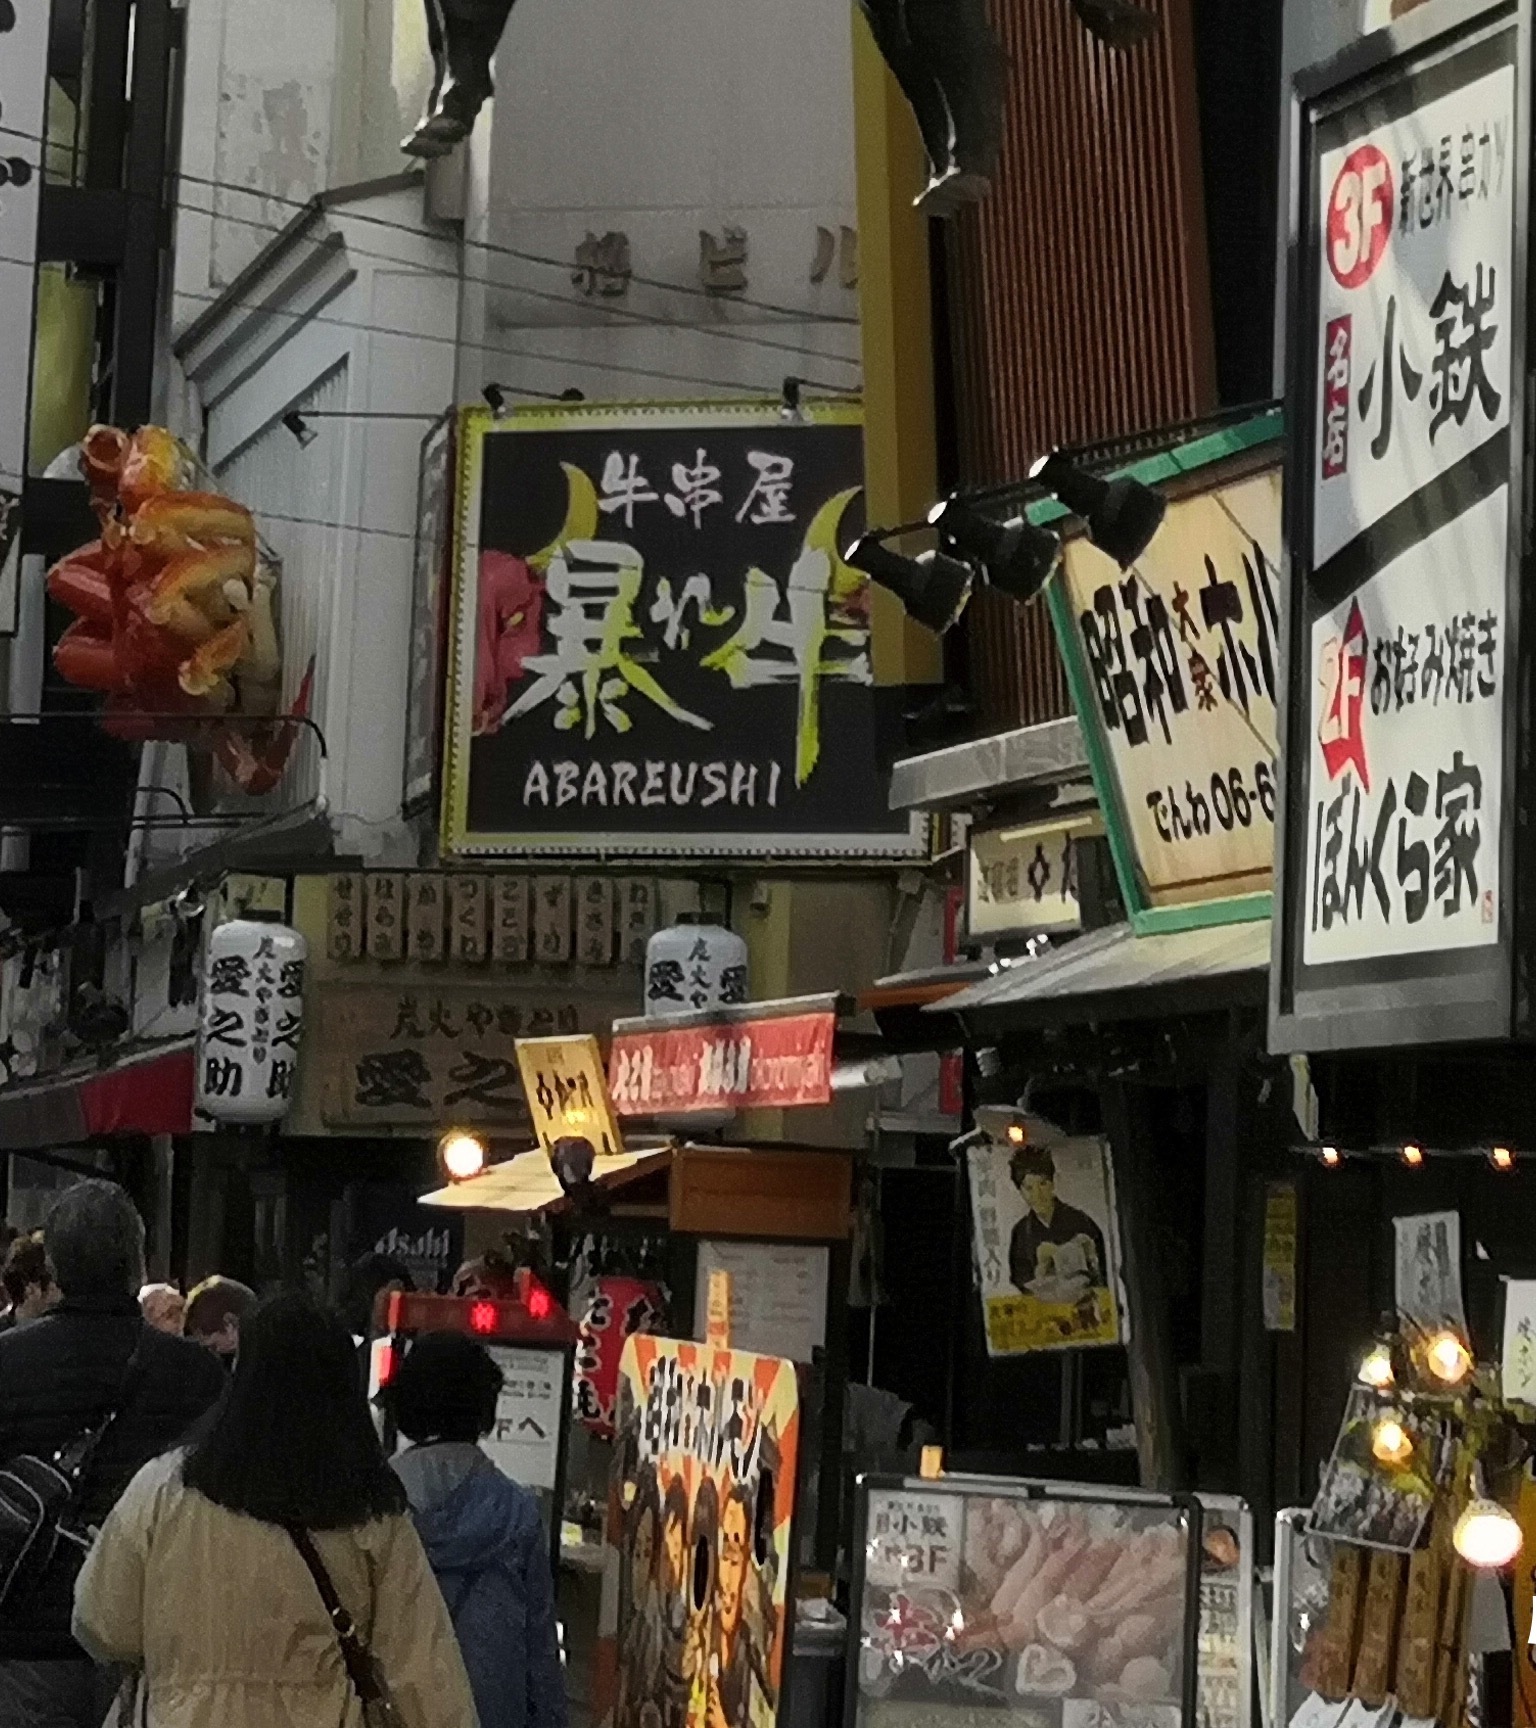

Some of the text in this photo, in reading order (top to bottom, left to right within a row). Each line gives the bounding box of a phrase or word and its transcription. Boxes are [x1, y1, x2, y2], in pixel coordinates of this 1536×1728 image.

[1333, 161, 1386, 275] 3F
[1358, 262, 1502, 460] 小鉄
[597, 448, 796, 529] 牛串屋
[1371, 609, 1498, 715] お好み焼き
[523, 760, 782, 807] ABAREUSHI
[1312, 751, 1483, 933] ぼんくら家
